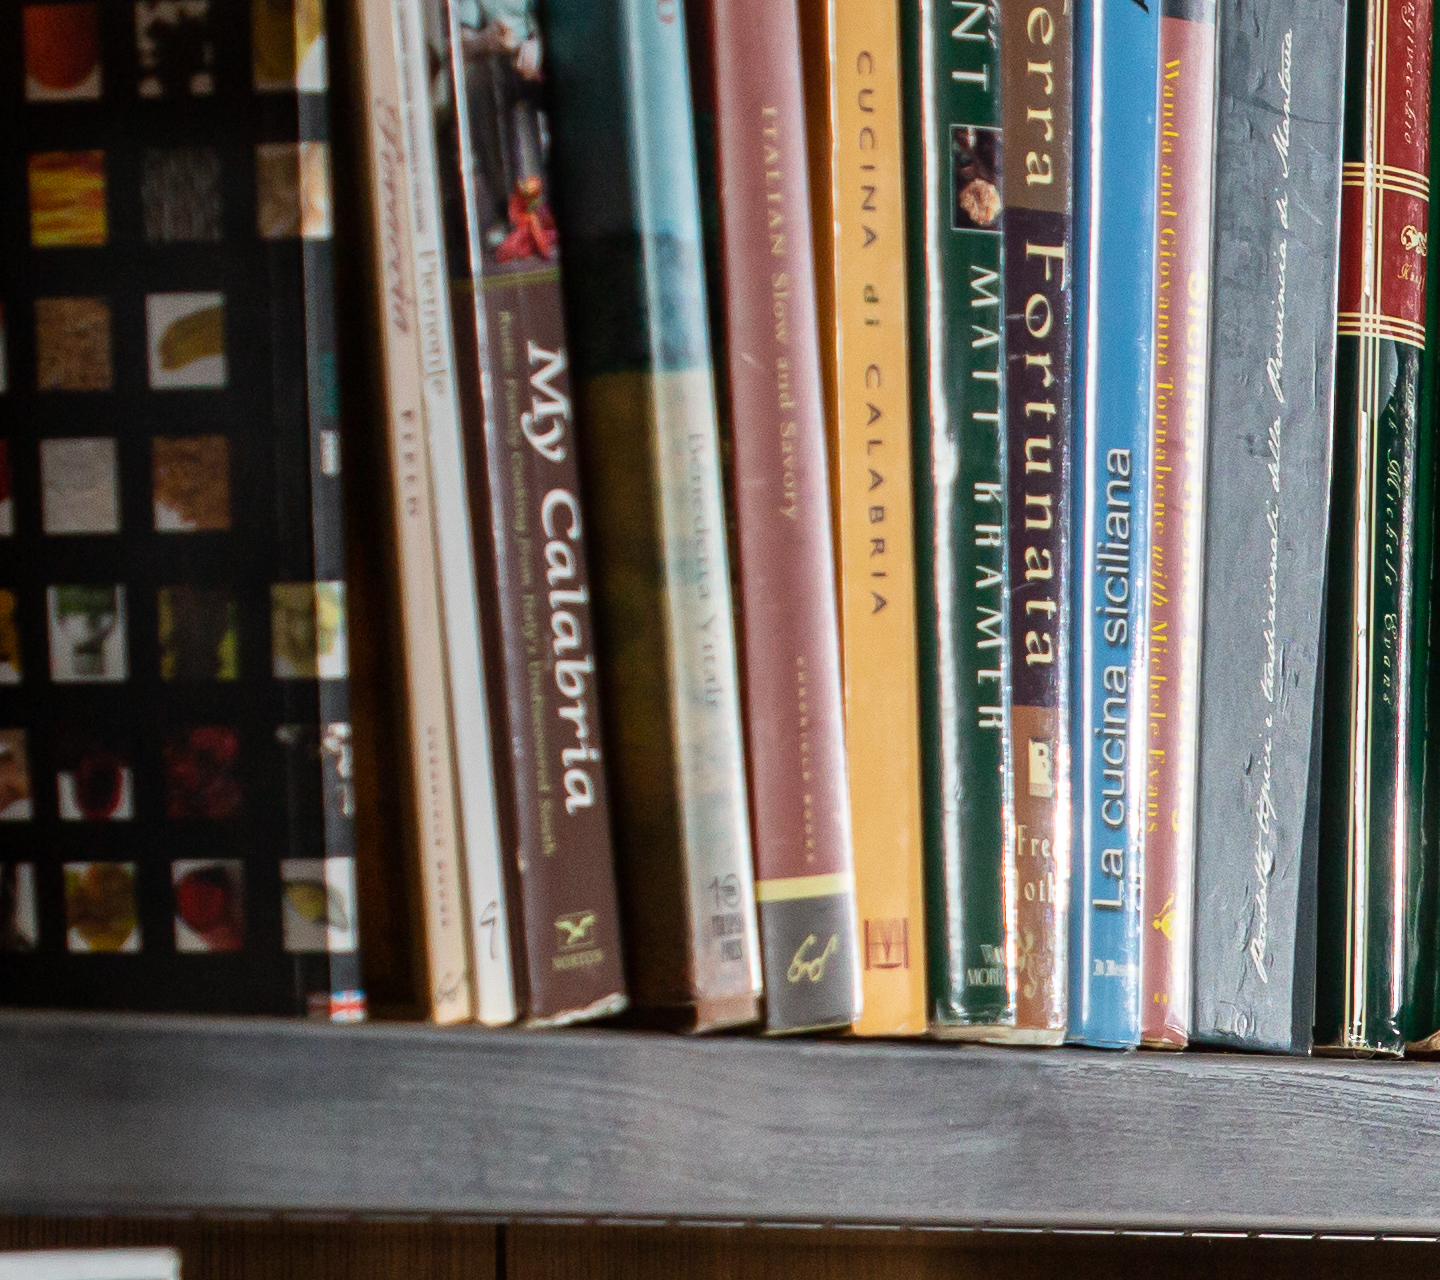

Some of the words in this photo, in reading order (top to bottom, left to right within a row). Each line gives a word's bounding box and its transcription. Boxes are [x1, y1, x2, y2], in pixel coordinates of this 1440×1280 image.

[856, 51, 879, 250] CUCINA
[1026, 0, 1057, 187] erra
[1160, 59, 1182, 154] Wanda
[1272, 28, 1294, 178] Mantova
[762, 106, 785, 256] ITALIAN
[1159, 164, 1178, 217] and
[863, 284, 881, 328] di
[970, 265, 1002, 426] MATT
[1157, 228, 1178, 367] Giovanna
[1265, 239, 1289, 404] Provincia
[521, 341, 571, 463] My
[776, 357, 796, 409] and
[1023, 241, 1067, 669] Fortunata
[778, 421, 798, 520] Savory
[864, 364, 889, 615] CALABRIA
[1384, 449, 1403, 587] Michele
[974, 483, 1005, 730] KRAMER
[1096, 447, 1132, 645] siciliana
[1151, 545, 1170, 607] with
[541, 488, 602, 815] Calabria
[1150, 620, 1170, 737] Michele
[1382, 613, 1399, 705] Evans
[1095, 665, 1129, 828] cucina
[1093, 848, 1126, 911] La
